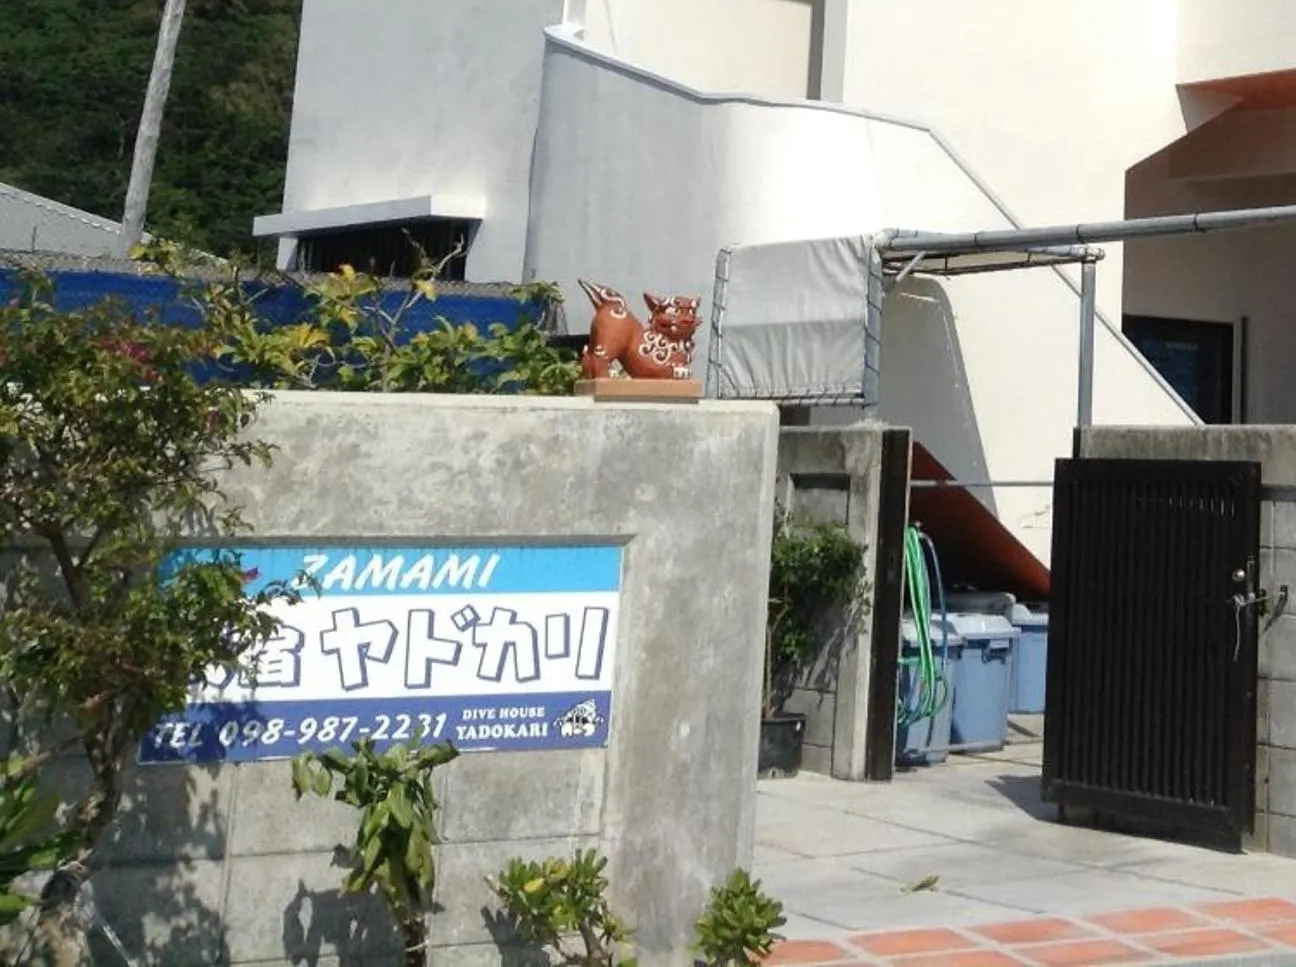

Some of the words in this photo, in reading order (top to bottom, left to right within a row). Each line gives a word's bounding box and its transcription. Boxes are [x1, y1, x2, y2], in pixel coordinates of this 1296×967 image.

[290, 554, 500, 591] ZAMAMI
[188, 605, 609, 690] 宿ヤドカリ
[154, 721, 203, 749] TEL
[218, 712, 448, 748] 098-987-2231
[455, 722, 549, 740] YADOKARI
[462, 708, 497, 721] DIVE
[499, 707, 546, 719] HOUSE
